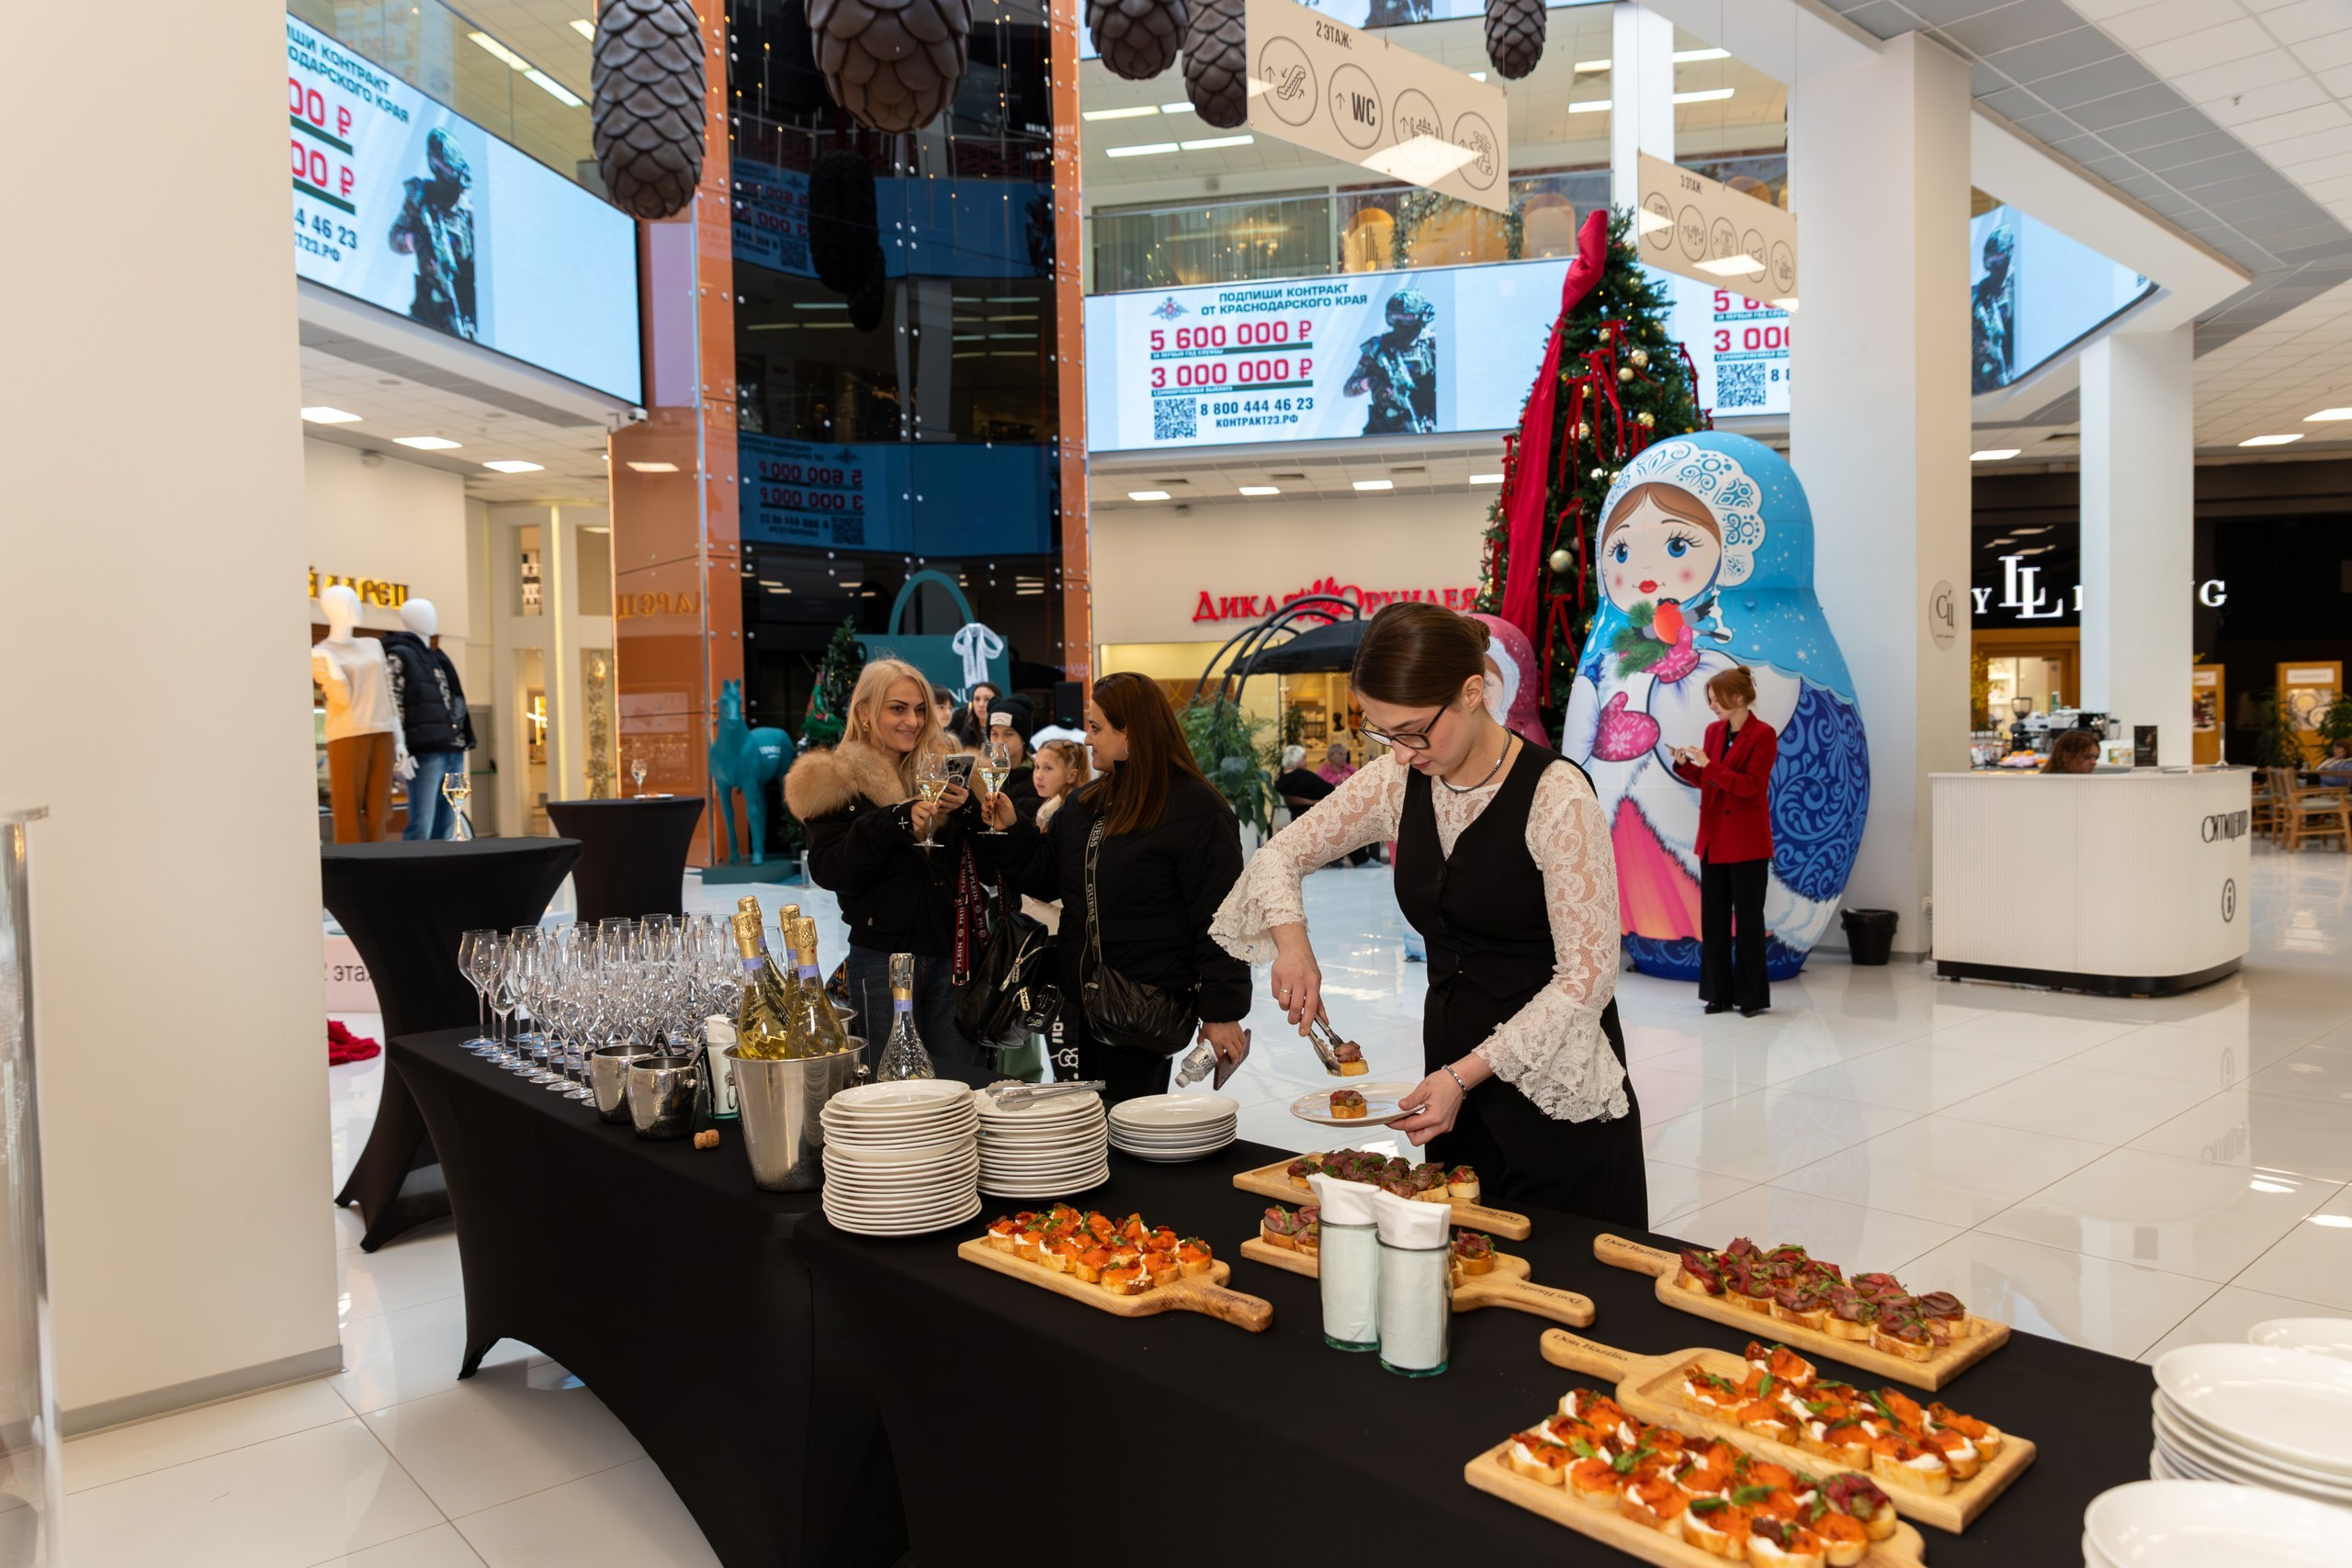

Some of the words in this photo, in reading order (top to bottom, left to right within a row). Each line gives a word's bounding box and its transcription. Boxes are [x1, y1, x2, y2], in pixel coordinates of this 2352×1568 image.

[1316, 20, 1322, 38] 2
[1324, 24, 1352, 51] ЭТАЖ:
[321, 43, 390, 94] КОНТРАКТ
[288, 45, 372, 103] ОДАРСКОГО
[375, 94, 410, 124] КРАЯ
[288, 77, 324, 127] 00
[1351, 91, 1375, 127] WC
[291, 140, 327, 187] 00
[337, 225, 358, 250] 23
[1201, 306, 1216, 316] ОТ
[1219, 297, 1332, 315] КРАСНОДАРСКОГО
[1335, 295, 1368, 306] КРАЯ
[1219, 288, 1283, 303] ПОДПИШИ
[1286, 284, 1349, 298] КОНТРАКТ
[1150, 330, 1165, 351] 5
[1176, 325, 1227, 349] 600
[1238, 321, 1289, 345] 000
[1713, 329, 1731, 352] 3
[1151, 367, 1166, 388] 3
[1177, 363, 1227, 387] 000
[1238, 358, 1289, 382] 000
[1770, 369, 1781, 381] 8
[1200, 403, 1208, 416] 8
[1214, 401, 1238, 415] 800
[1243, 400, 1269, 412] 444
[1274, 399, 1292, 412] 46
[1296, 397, 1314, 410] 23
[1216, 414, 1299, 428] КОНТРАКТ23.РФ
[1087, 883, 1096, 923] GUESS
